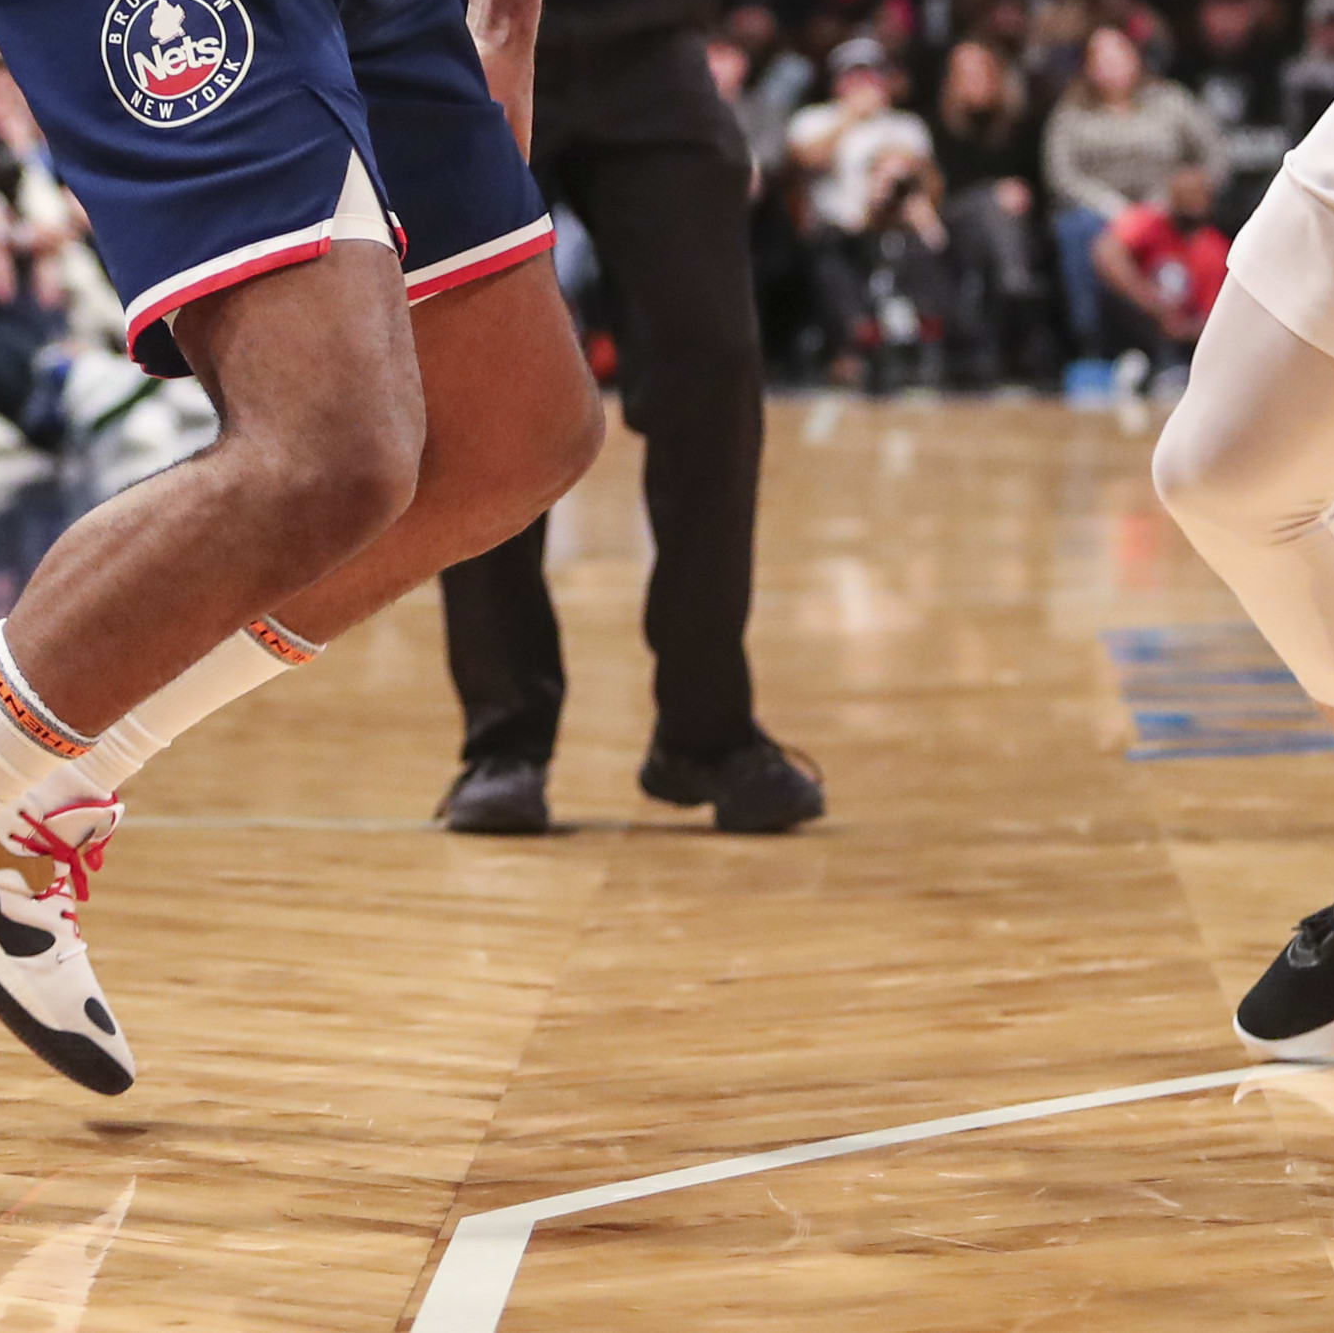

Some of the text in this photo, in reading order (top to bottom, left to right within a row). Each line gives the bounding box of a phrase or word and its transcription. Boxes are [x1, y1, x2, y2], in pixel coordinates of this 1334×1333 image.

[130, 58, 242, 119] NEW YORK
[133, 35, 223, 89] Nets
